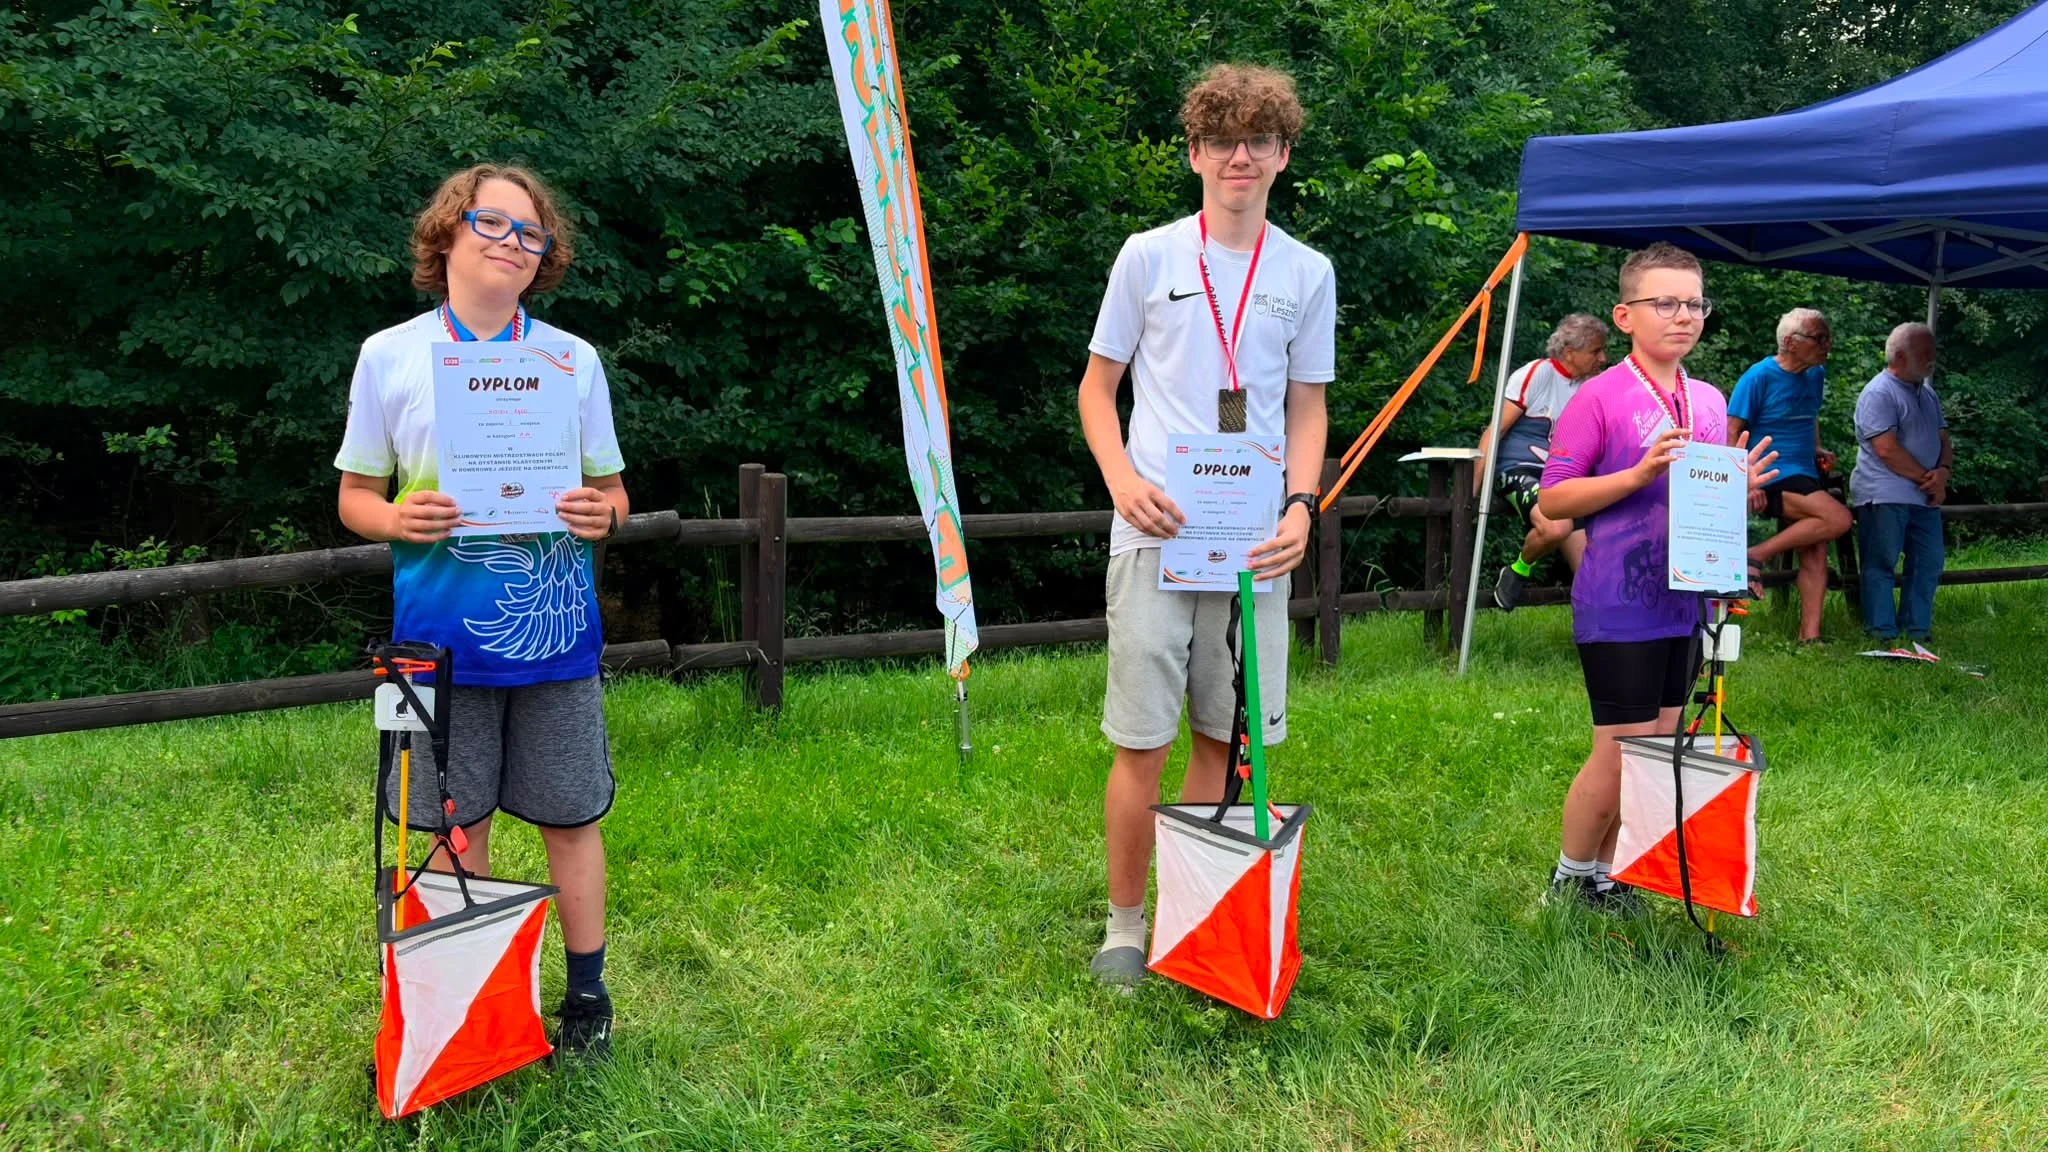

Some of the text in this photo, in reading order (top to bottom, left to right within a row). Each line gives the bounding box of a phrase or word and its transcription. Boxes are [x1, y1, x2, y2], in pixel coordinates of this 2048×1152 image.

[468, 376, 540, 392] DYPLOM
[1193, 463, 1251, 477] DYPLOM
[1689, 468, 1729, 484] DYPLOM
